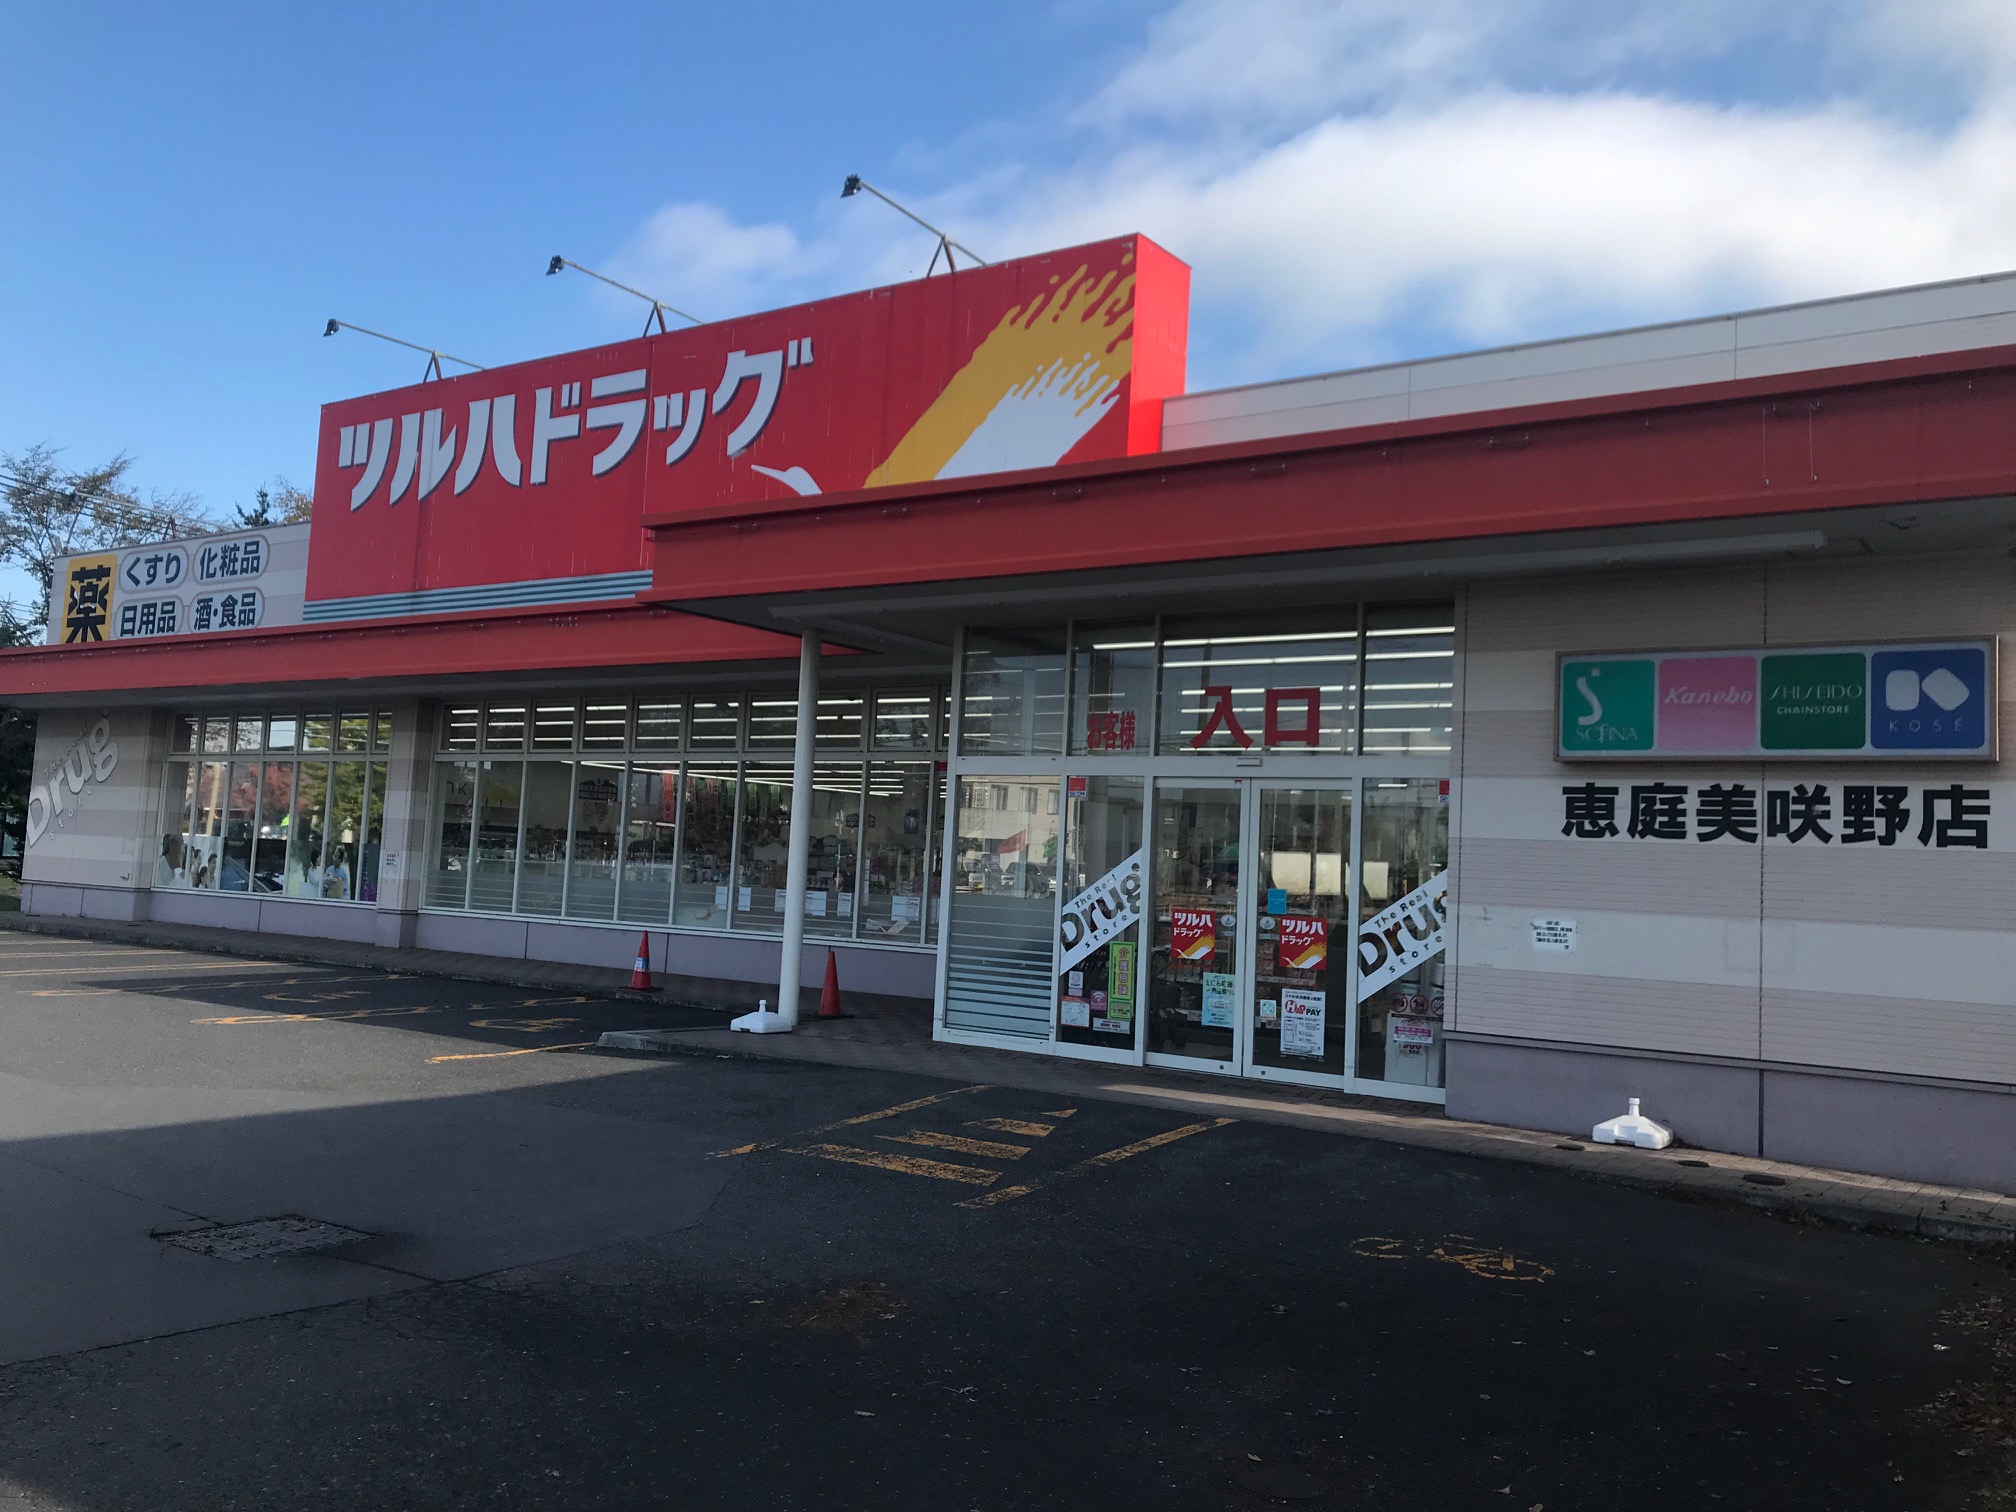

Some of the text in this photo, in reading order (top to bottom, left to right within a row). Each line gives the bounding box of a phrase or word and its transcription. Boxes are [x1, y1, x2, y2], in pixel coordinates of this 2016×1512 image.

[337, 336, 814, 512] ツルハドラッグ
[125, 552, 182, 587] くすり
[199, 540, 260, 580] 化粧品
[65, 564, 112, 643] 薬
[119, 600, 176, 637] 日用品
[1663, 686, 1754, 705] Kanebo
[1769, 684, 1863, 700] SHISEIDO
[1776, 704, 1851, 715] CHAINSTORE
[1086, 685, 1321, 750] お客様 入口
[26, 709, 119, 849] Drug
[1561, 782, 1991, 849] 恵庭美咲野店
[1061, 862, 1141, 953] Drug
[1074, 893, 1092, 909] The
[1374, 889, 1429, 929] The Real
[1084, 914, 1128, 949] store
[1173, 912, 1213, 928] ツルハ
[1173, 927, 1204, 938] ドラッグ
[1281, 918, 1325, 936] ツルハ
[1281, 934, 1315, 946] ドラッグ
[1388, 934, 1444, 974] store
